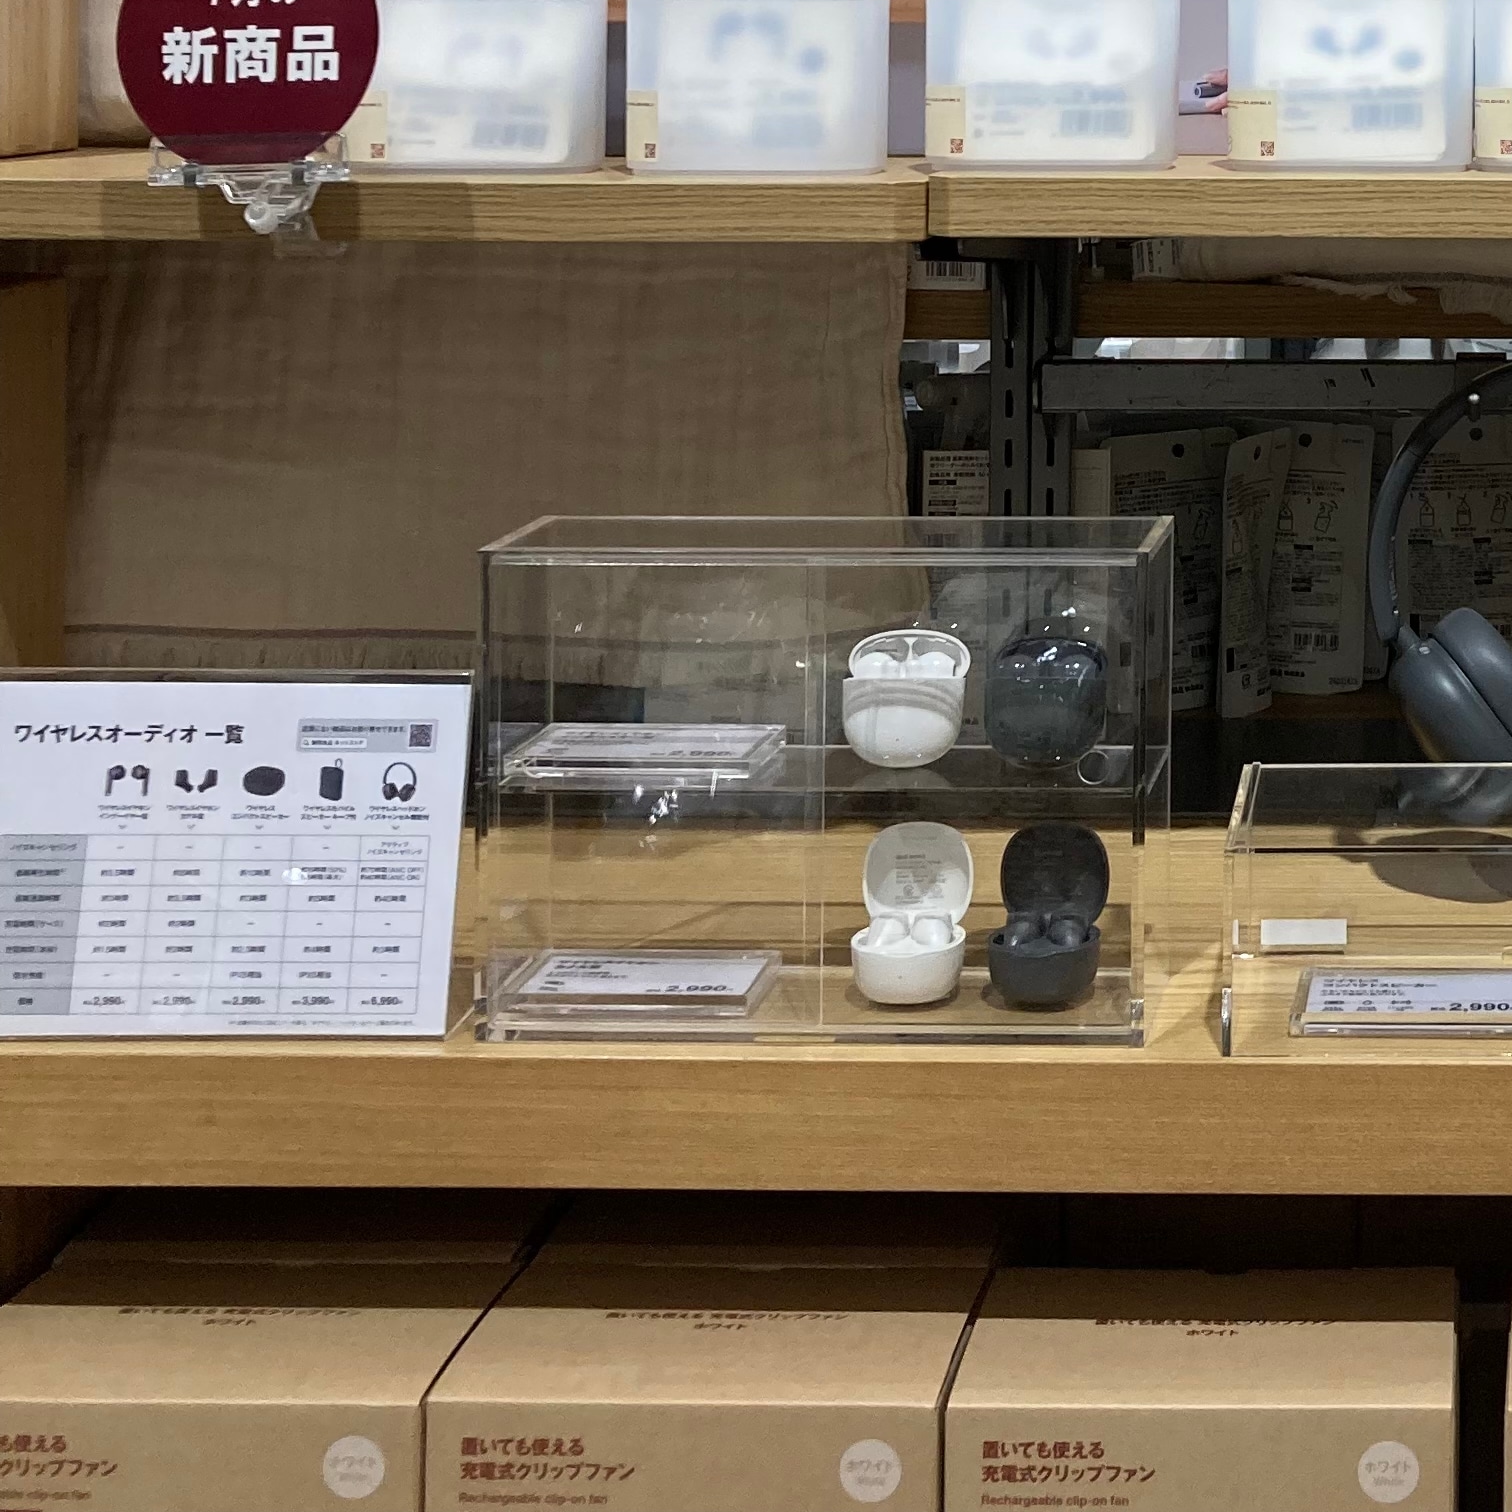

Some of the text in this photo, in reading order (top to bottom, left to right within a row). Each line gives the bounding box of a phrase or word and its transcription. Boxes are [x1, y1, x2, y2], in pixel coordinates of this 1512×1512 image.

[161, 24, 341, 85] 新商品
[14, 724, 245, 745] ワイヤレスオーディオ 一覧
[461, 1437, 585, 1456] 置いても使える
[982, 1441, 1105, 1460] 置いても使える
[461, 1462, 635, 1482] 充電式クリップファン
[981, 1464, 1156, 1483] 充電式クリップファン
[1364, 1460, 1411, 1474] ホワイト
[981, 1495, 1130, 1508] Rechargeable clip-on fan
